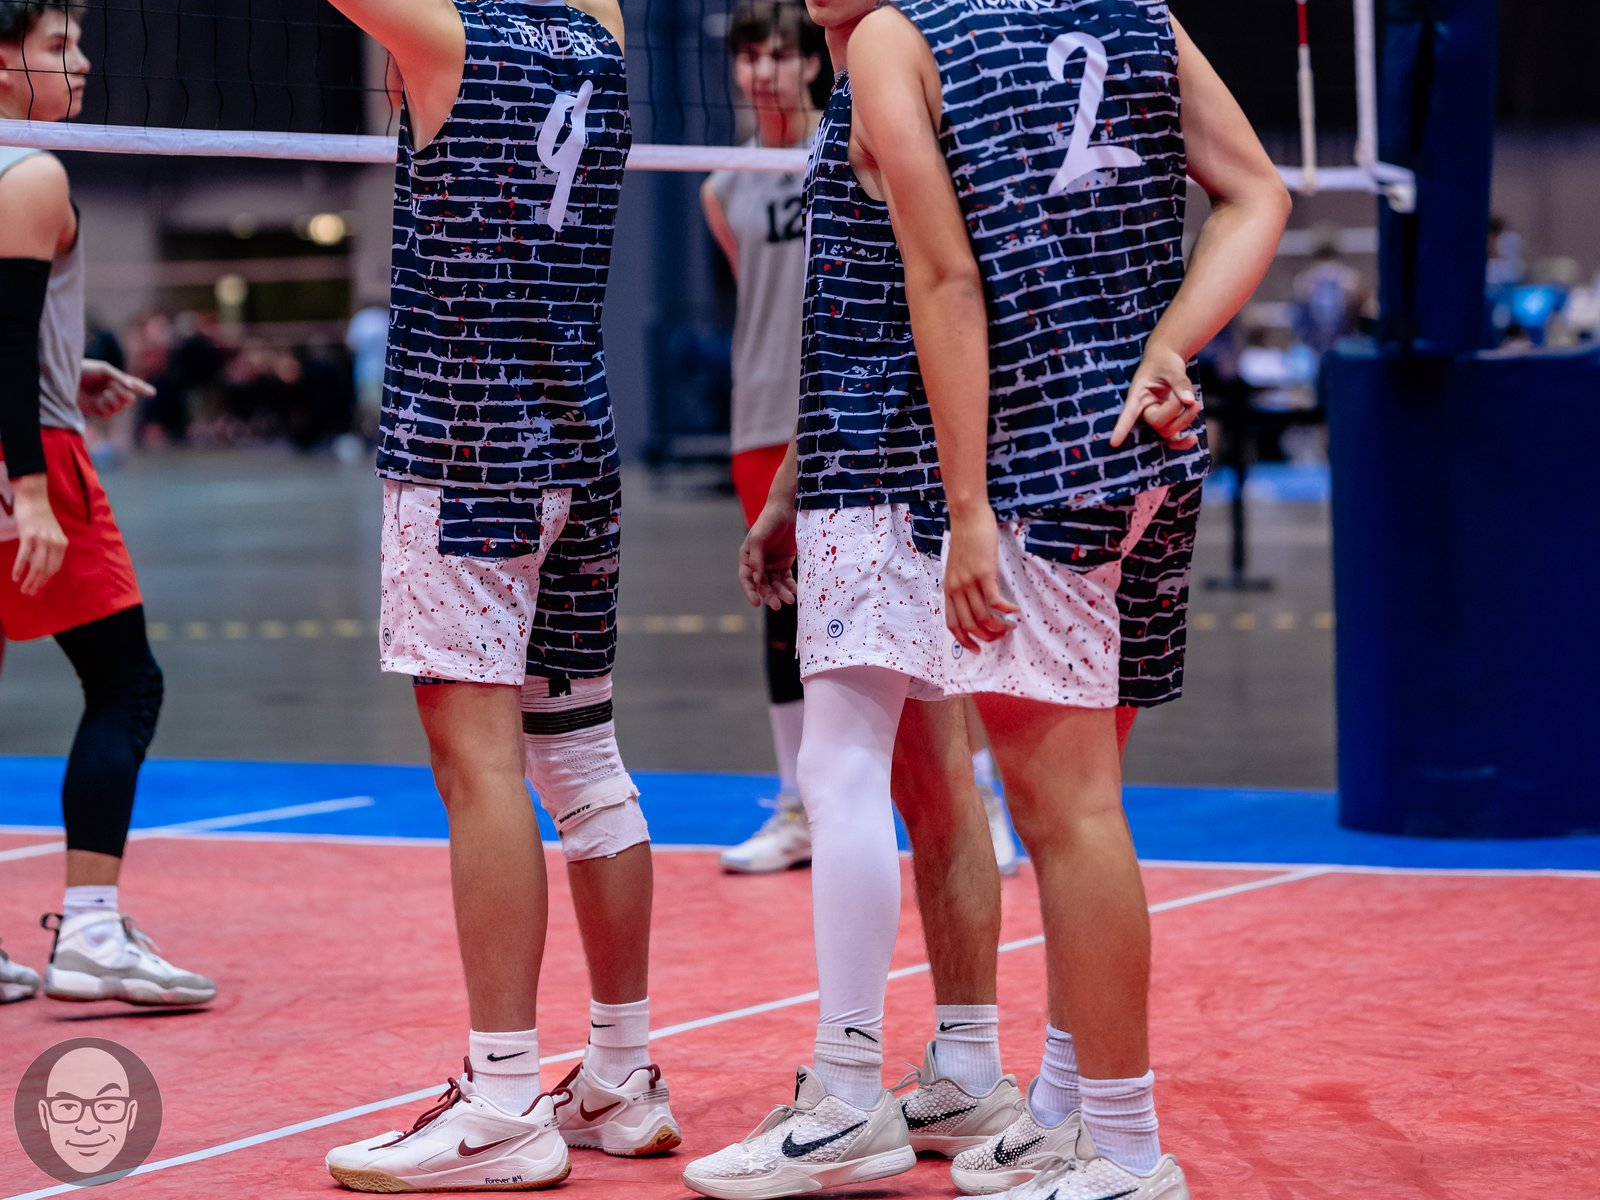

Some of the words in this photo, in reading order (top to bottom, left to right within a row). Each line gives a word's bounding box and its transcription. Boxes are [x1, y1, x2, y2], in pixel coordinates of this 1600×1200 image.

[537, 80, 593, 231] 9
[1047, 31, 1142, 195] 2
[767, 196, 804, 243] 12
